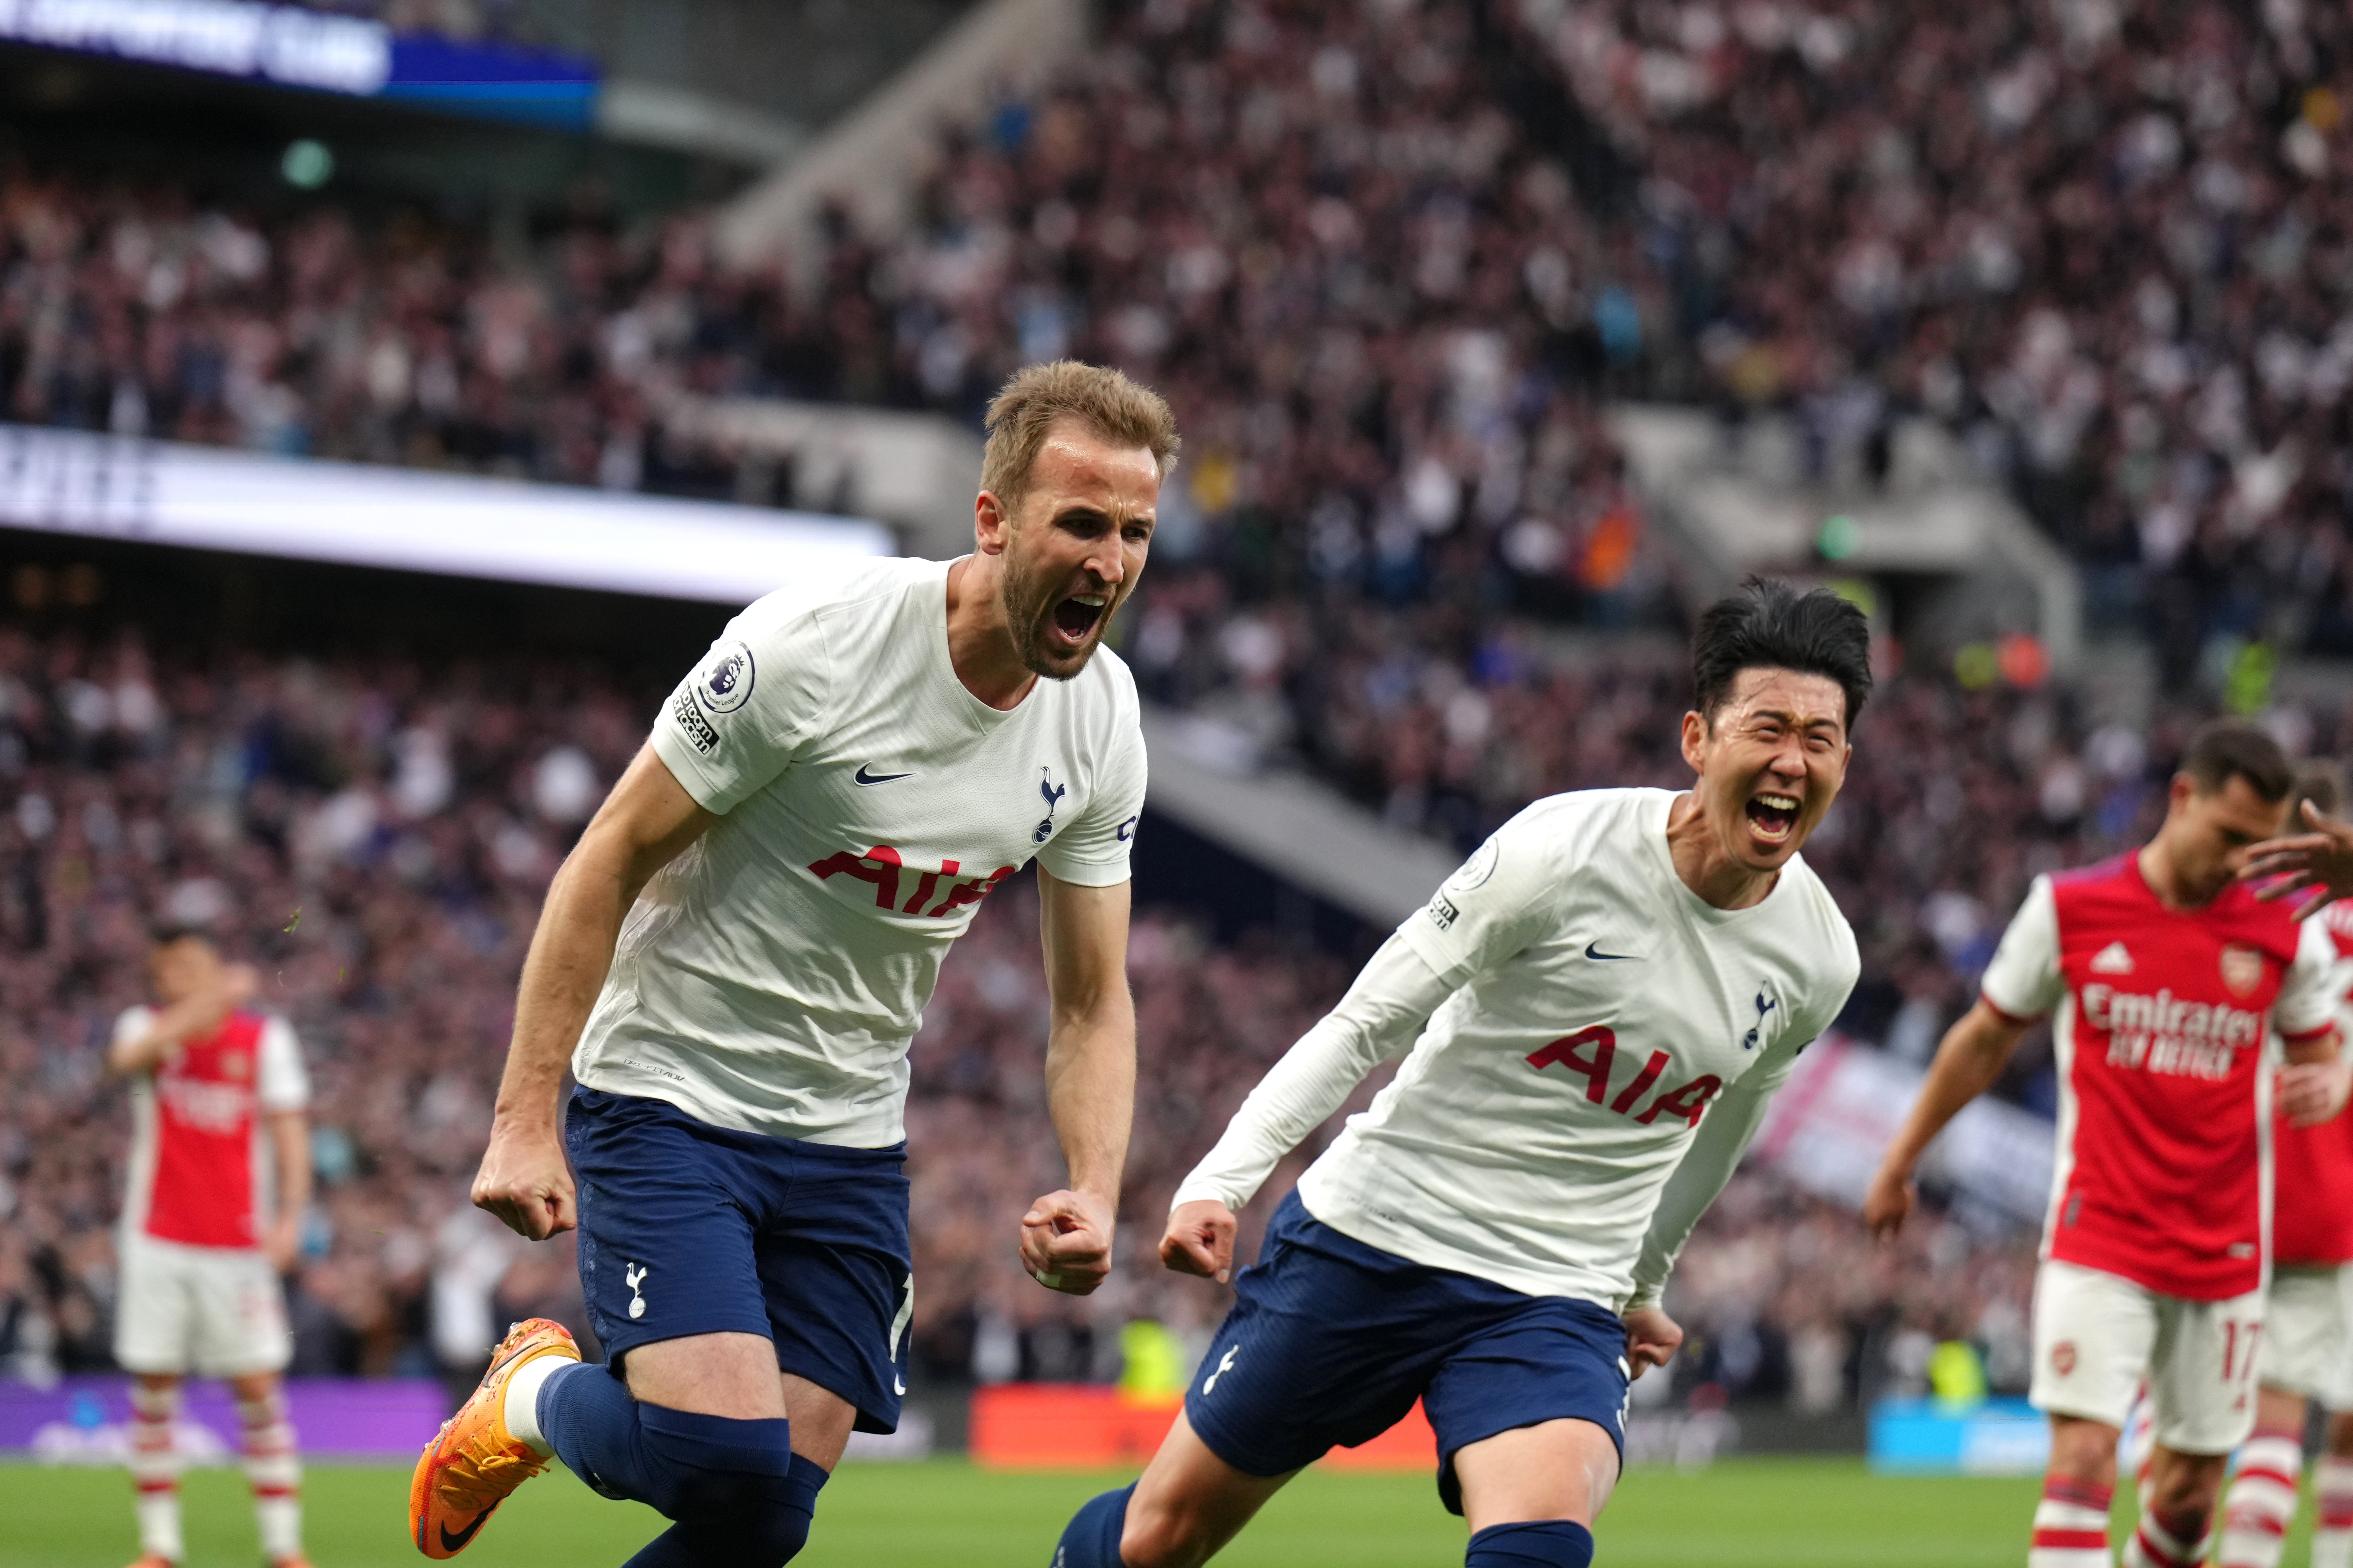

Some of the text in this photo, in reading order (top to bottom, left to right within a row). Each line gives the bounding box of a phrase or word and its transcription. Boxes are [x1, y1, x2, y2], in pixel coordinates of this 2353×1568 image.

[685, 702, 713, 740] room
[706, 690, 739, 705] Premier League
[676, 709, 710, 754] racism
[807, 845, 1015, 918] AIA
[1526, 1025, 1720, 1129] AIA
[2221, 1319, 2265, 1381] 17
